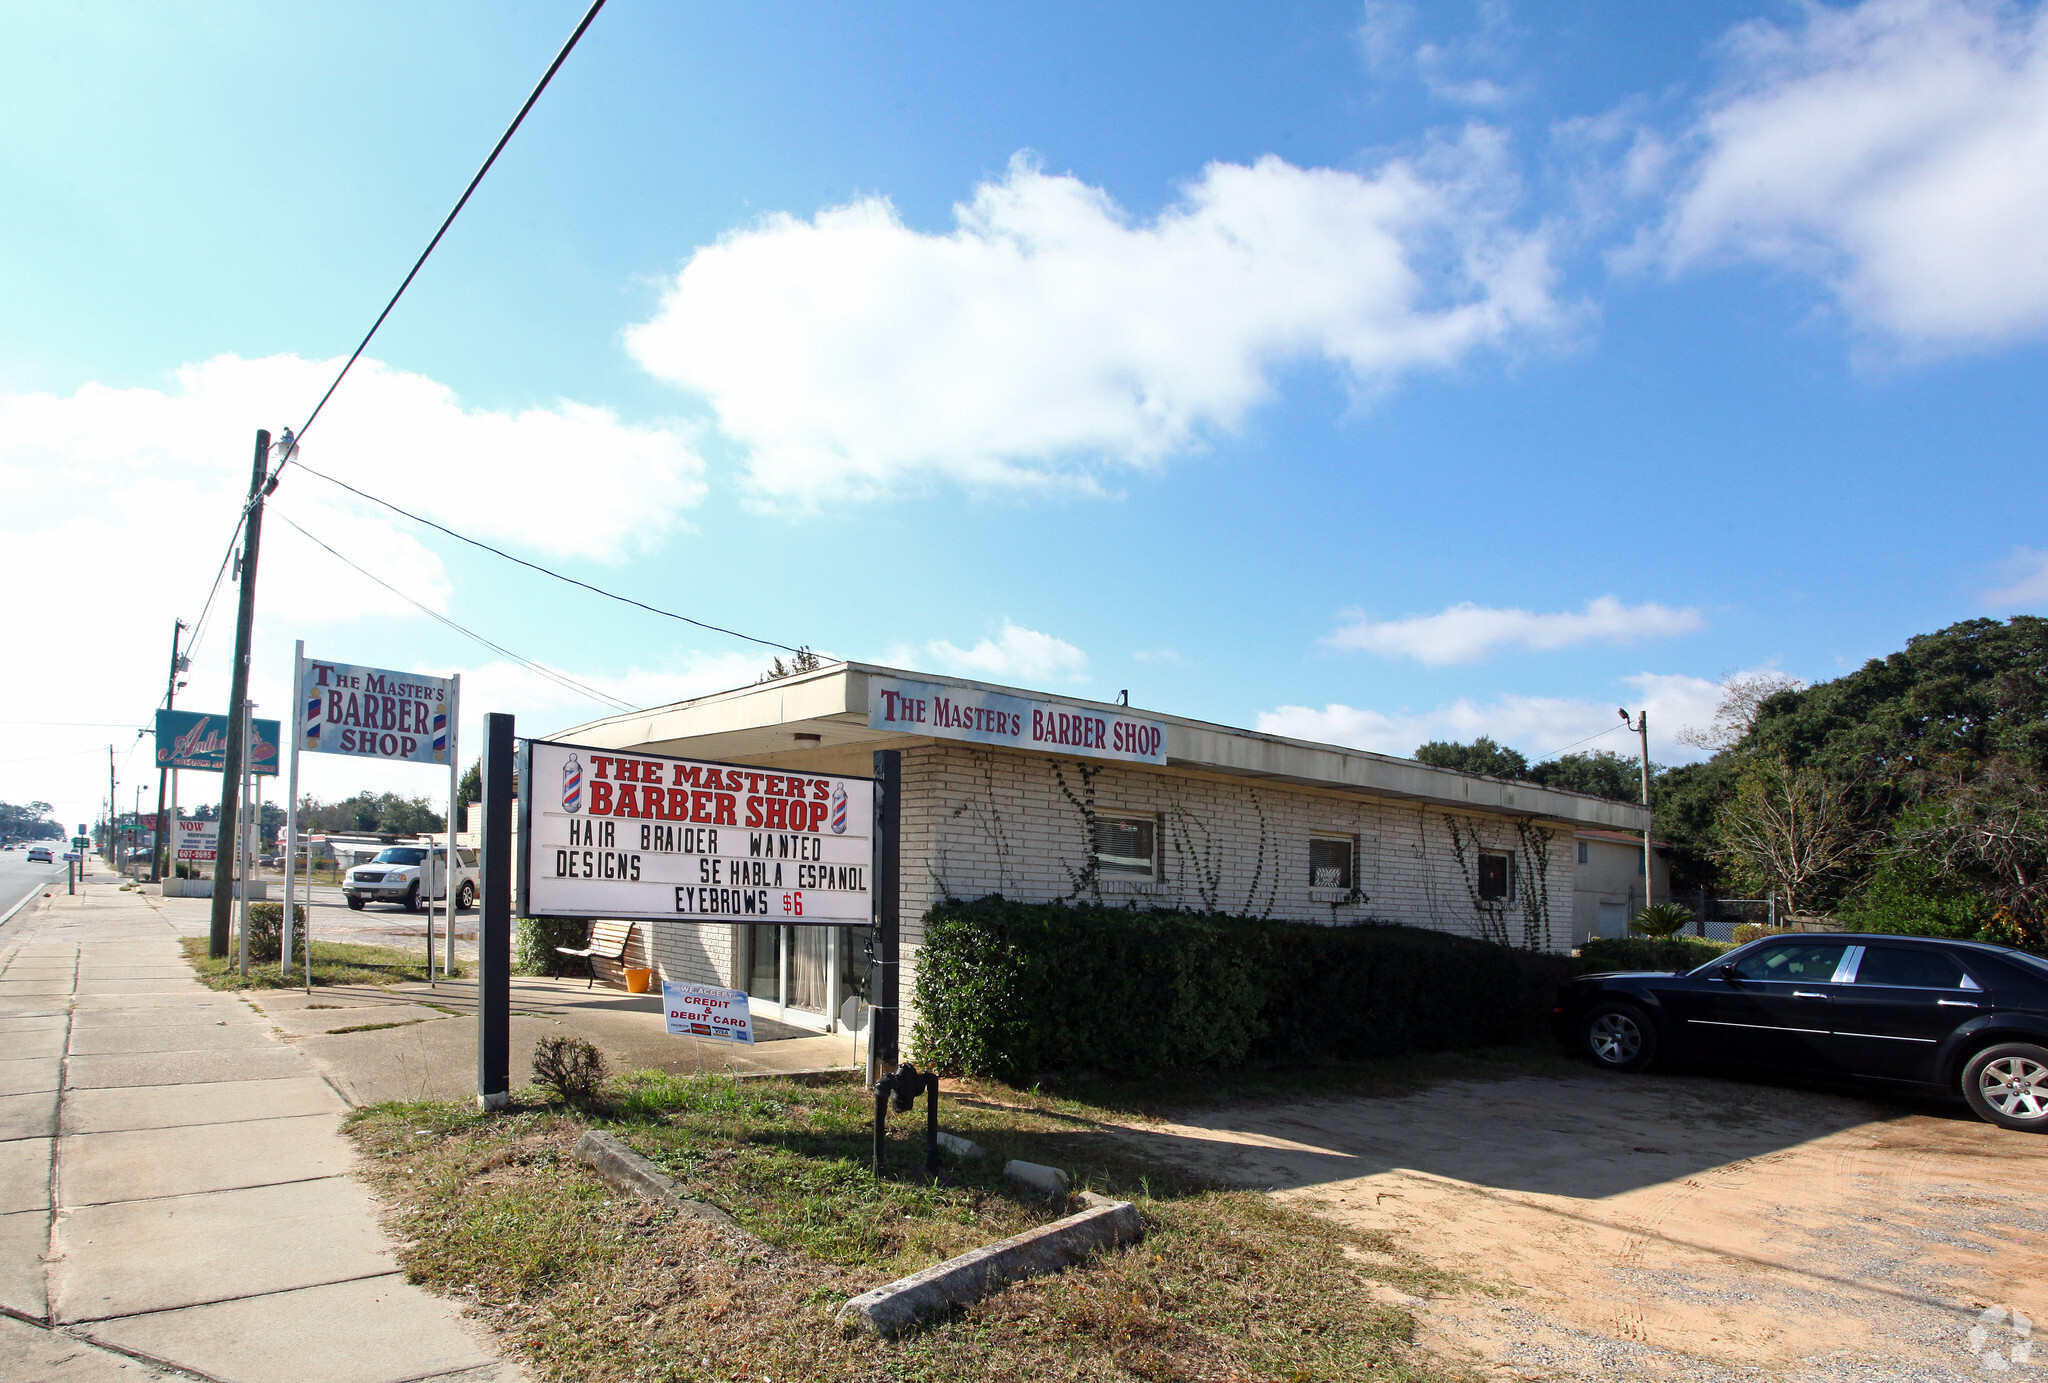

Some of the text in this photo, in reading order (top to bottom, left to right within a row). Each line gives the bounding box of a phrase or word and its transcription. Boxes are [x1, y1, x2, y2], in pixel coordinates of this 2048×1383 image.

[326, 689, 430, 735] BARBER
[340, 728, 417, 758] SHOP
[1032, 709, 1106, 749] BARBER
[1113, 721, 1161, 756] SHOP
[590, 755, 830, 801] THE MASTER'S
[589, 781, 829, 832] BARBER SHOP
[179, 821, 204, 832] NOW
[570, 819, 821, 861] HAIR BRAIDER WANTED
[556, 849, 867, 891] DESIGNS SE HABLA ESPANOL
[675, 886, 803, 915] EYEBROWS $6
[681, 986, 733, 999] WE ACCEPT
[684, 996, 730, 1008] CREDIT
[671, 1011, 747, 1027] DEBIT CARD
